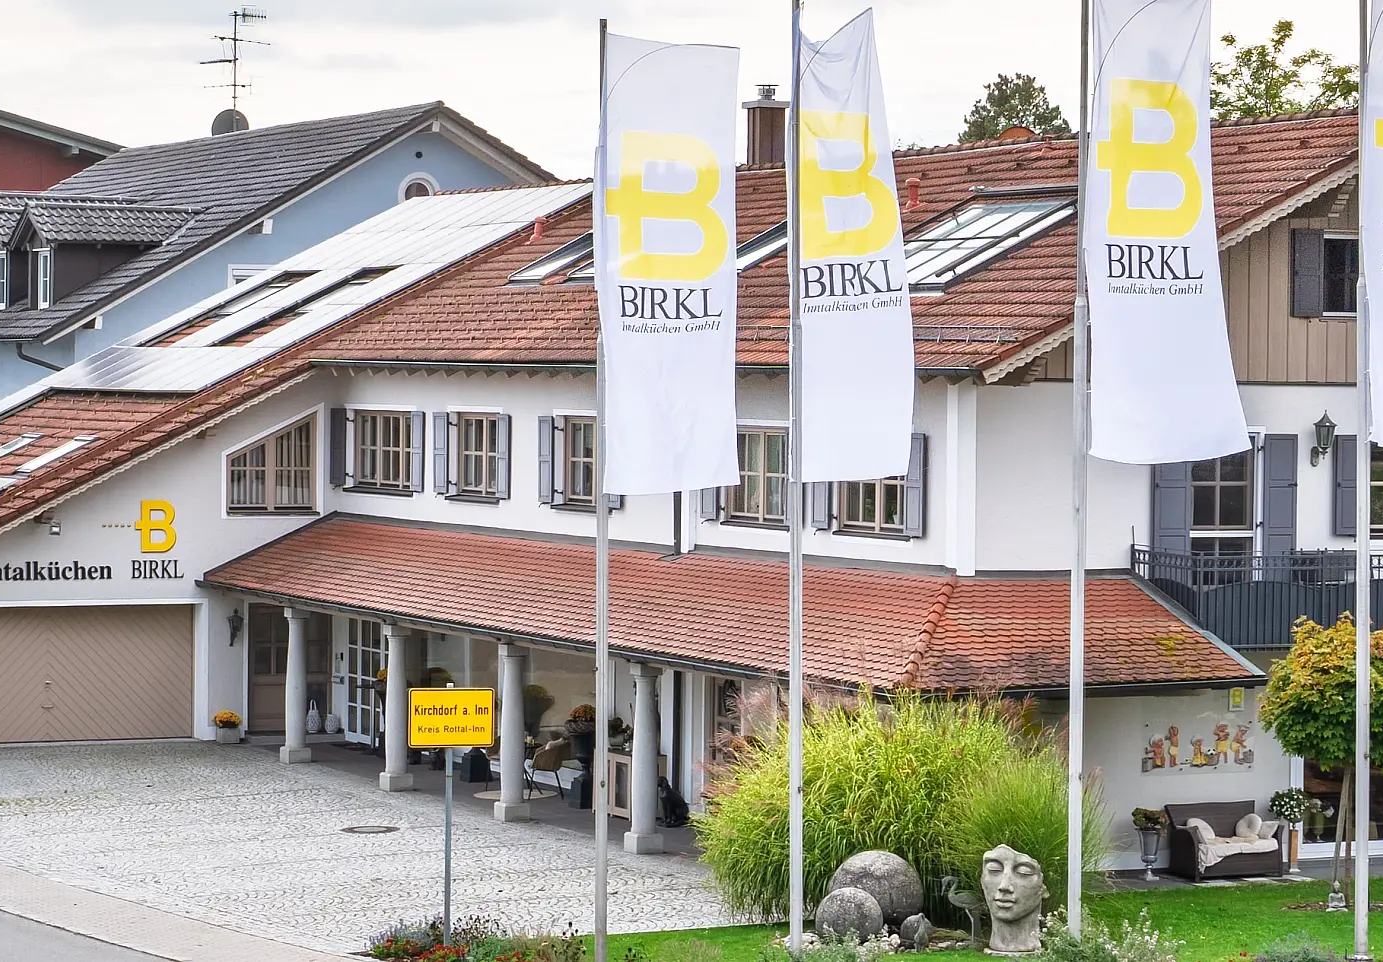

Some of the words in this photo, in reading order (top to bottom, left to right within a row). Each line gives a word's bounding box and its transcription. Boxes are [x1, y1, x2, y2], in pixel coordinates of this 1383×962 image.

[1096, 78, 1203, 238] B
[606, 131, 728, 281] B
[1104, 243, 1203, 280] BIRKL
[800, 259, 903, 299] BIRKL
[1108, 282, 1166, 295] Inntalküchen
[1168, 283, 1204, 296] GmbH
[618, 285, 723, 320] BIRKL
[871, 296, 903, 309] GmbH
[684, 320, 721, 333] GmbH
[135, 499, 177, 553] B
[131, 559, 185, 579] BIRKL
[414, 704, 458, 716] Kirchdorf
[462, 707, 470, 716] a.
[475, 704, 489, 716] Inn
[417, 725, 440, 733] Kreis
[443, 724, 486, 733] Rottal-Inn
